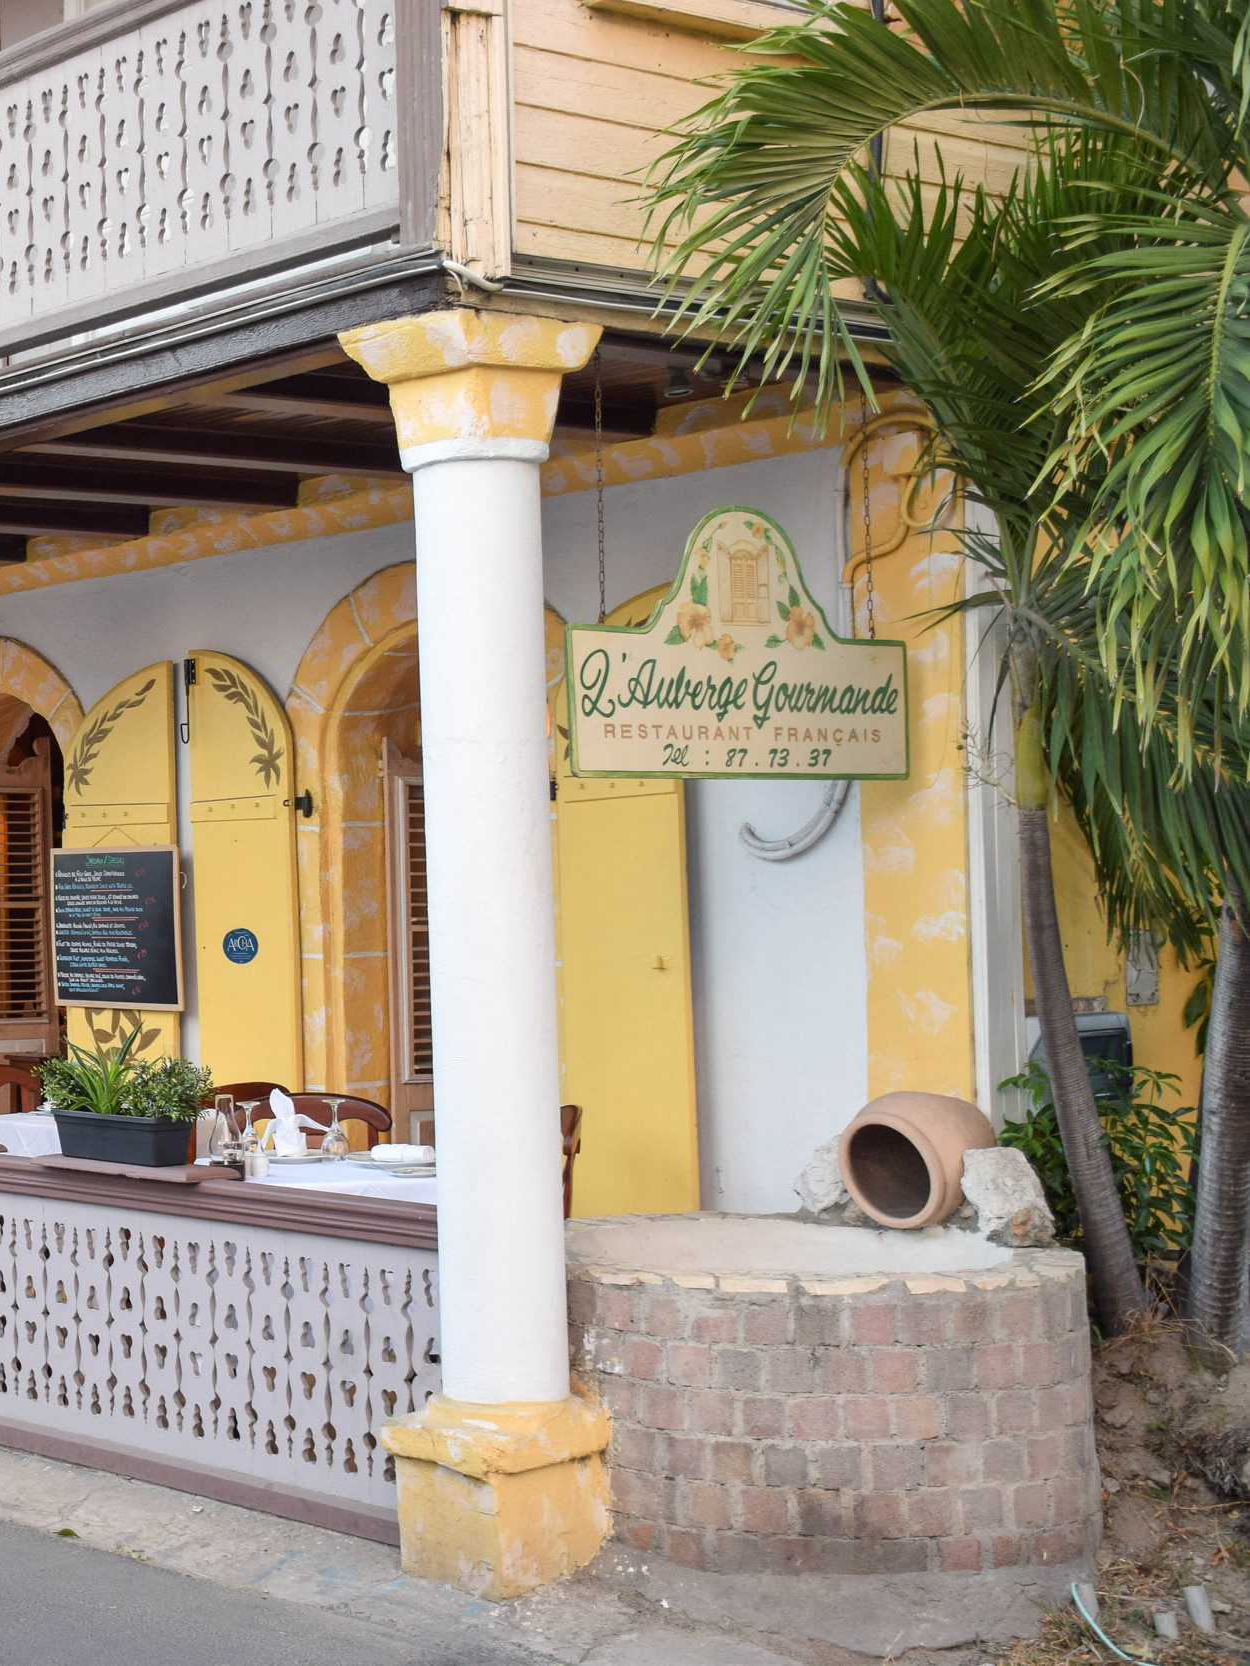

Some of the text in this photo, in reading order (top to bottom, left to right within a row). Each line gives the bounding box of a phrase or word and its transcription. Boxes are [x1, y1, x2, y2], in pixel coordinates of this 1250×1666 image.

[580, 649, 747, 722] L'Auberge
[752, 661, 898, 729] Gourmande
[603, 723, 882, 746] RESTAURANT FRANÇAIS
